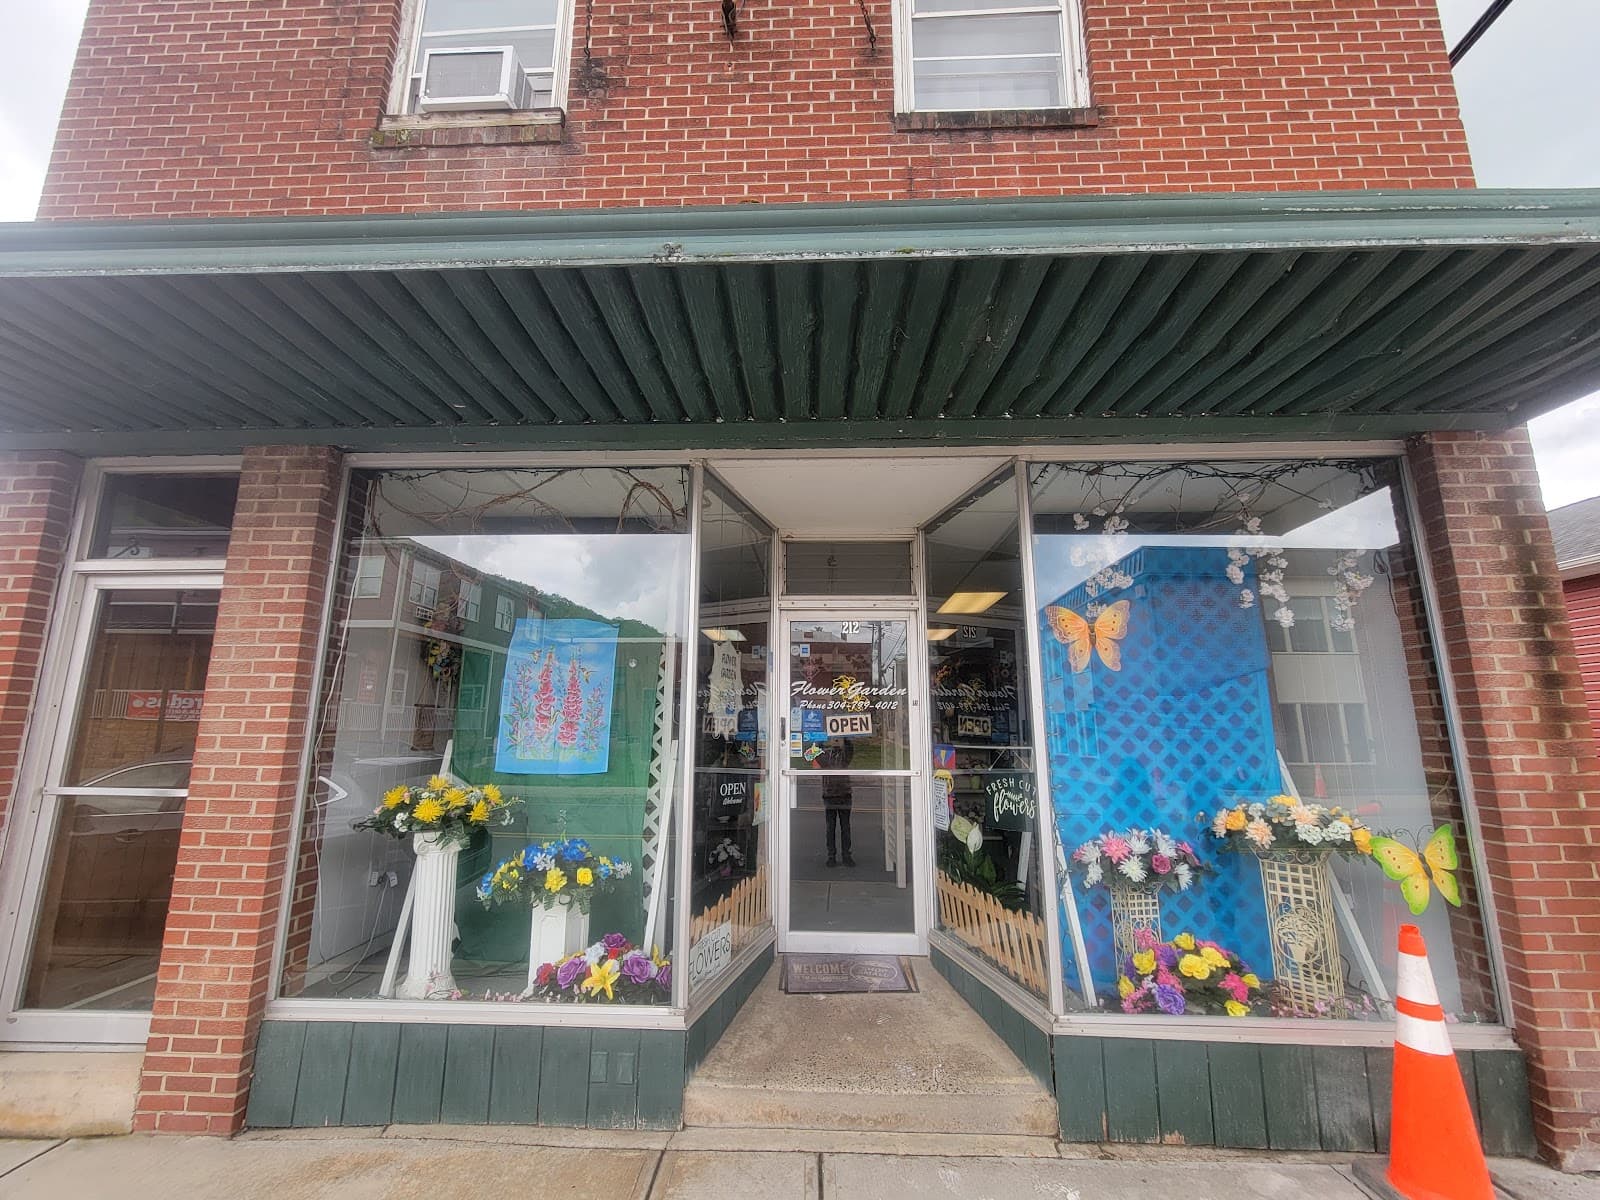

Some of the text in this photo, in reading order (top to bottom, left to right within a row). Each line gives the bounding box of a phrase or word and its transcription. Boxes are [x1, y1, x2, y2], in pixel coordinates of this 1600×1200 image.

[842, 621, 860, 634] 212
[791, 681, 908, 699] Flower Garden
[829, 717, 870, 733] OPEN
[720, 782, 746, 796] OPEN
[986, 778, 1037, 796] FRESH CUT
[993, 789, 1037, 822] flowers
[793, 963, 847, 974] WELCOME
